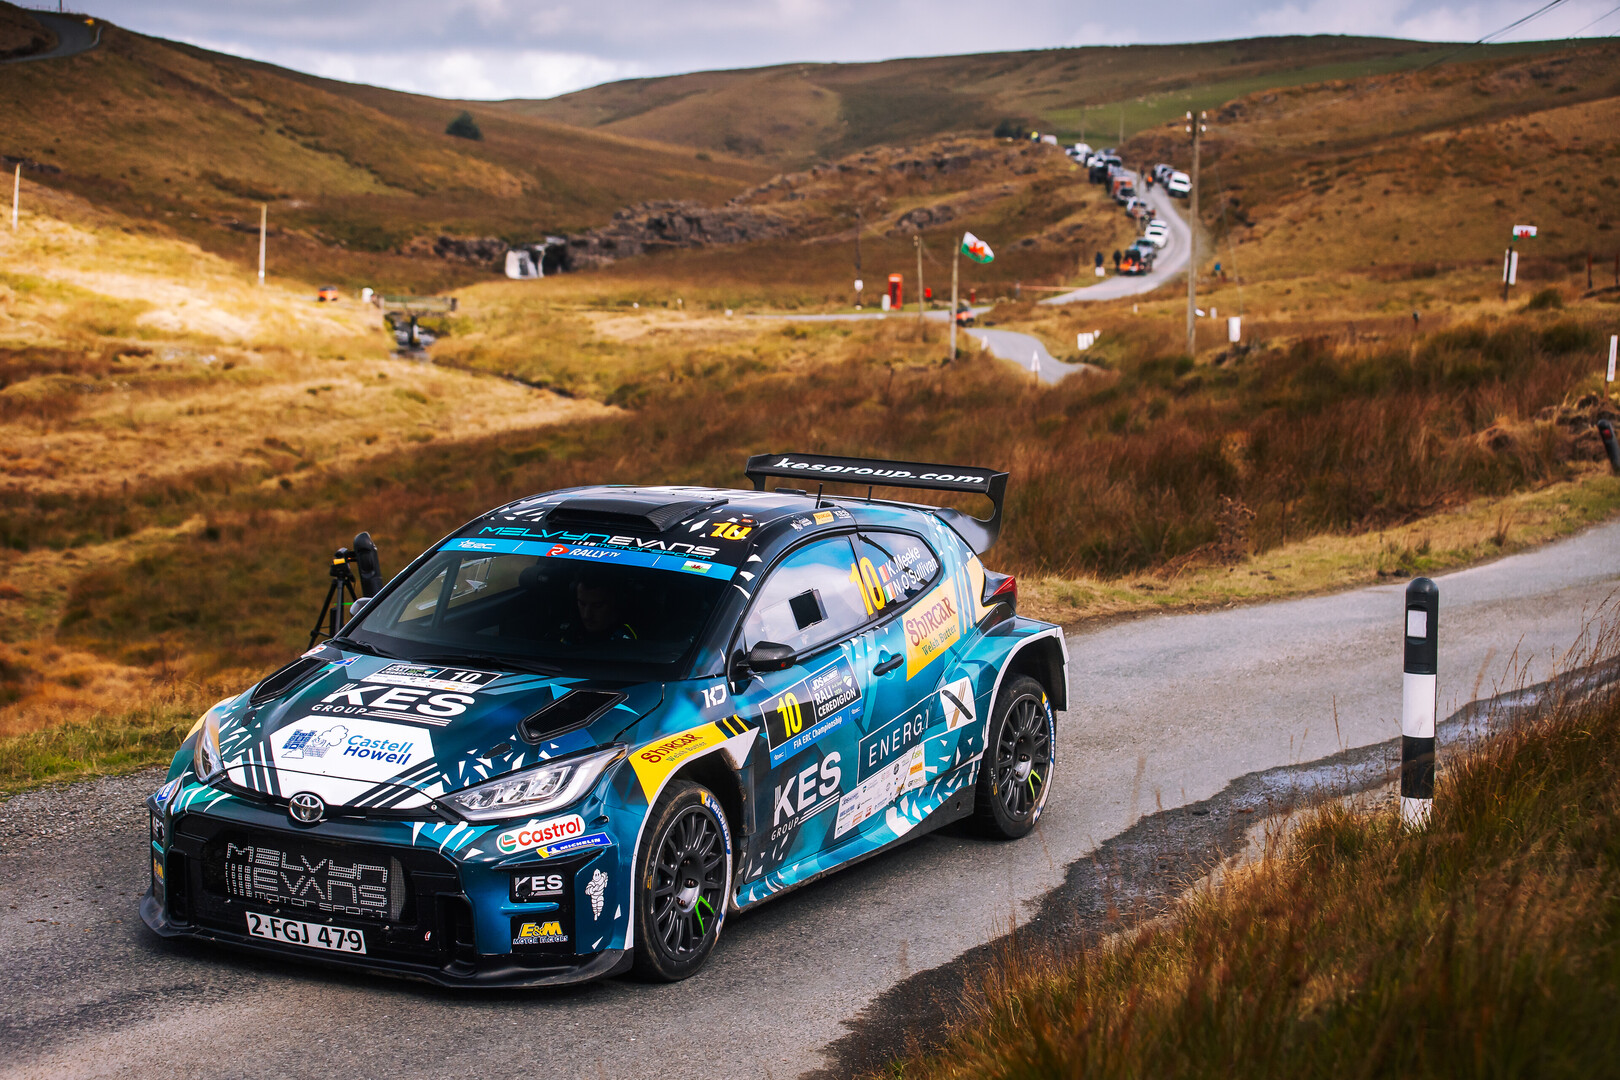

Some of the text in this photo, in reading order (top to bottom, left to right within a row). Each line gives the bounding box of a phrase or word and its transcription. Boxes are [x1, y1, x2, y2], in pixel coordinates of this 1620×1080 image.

[773, 457, 985, 485] kesgroup.com
[710, 521, 753, 541] 10
[595, 542, 712, 560] MOTORSPORT
[848, 556, 886, 616] 10
[922, 625, 957, 656] Welsh Butter
[450, 671, 483, 683] 10
[311, 703, 368, 715] GROUP
[320, 683, 476, 717] KES
[814, 685, 834, 706] RALI
[817, 687, 857, 717] CEREDIGION
[776, 692, 803, 738] 10
[347, 734, 414, 754] Castell
[793, 716, 843, 750] FIA ERC Championship
[343, 745, 412, 766] Howell
[666, 750, 688, 762] Welsh
[773, 751, 842, 827] KES
[518, 817, 581, 846] Castrol
[710, 800, 732, 852] MICHELIN
[770, 816, 800, 841] GROUP
[559, 838, 601, 851] MICHELIN
[226, 842, 389, 884] MELVYN
[253, 866, 388, 908] EVANS
[514, 874, 564, 892] KES
[254, 890, 388, 919] MOTORSPORT
[317, 926, 363, 952] 479
[519, 921, 563, 938] E&M
